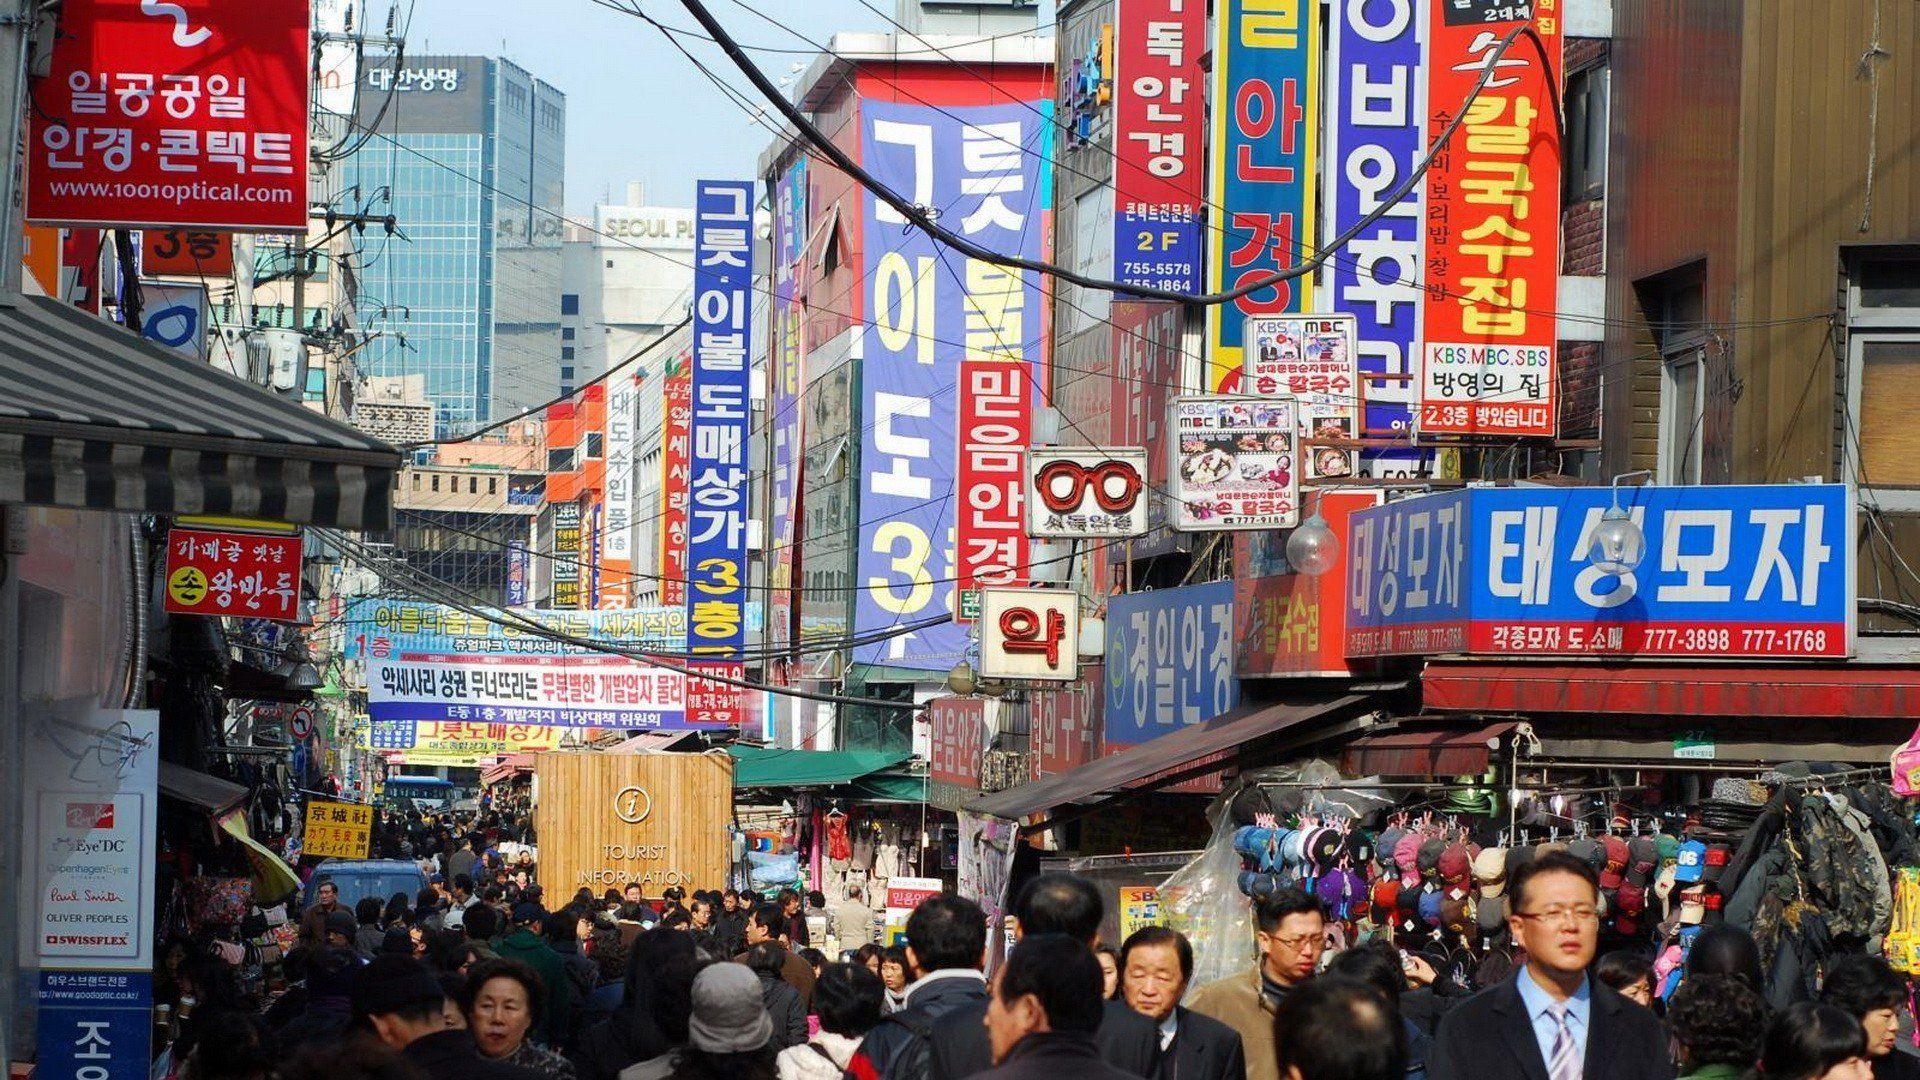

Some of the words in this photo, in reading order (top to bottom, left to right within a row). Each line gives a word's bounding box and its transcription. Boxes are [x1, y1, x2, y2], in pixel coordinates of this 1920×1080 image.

[1451, 32, 1530, 88] 손
[369, 68, 458, 91] 대한생명
[1128, 0, 1190, 178] 독안경
[69, 70, 246, 119] 일공공일
[873, 119, 1025, 236] 그릇
[50, 181, 292, 205] www.1001optical.com
[605, 218, 671, 238] SEOUL
[1458, 96, 1538, 336] 칼국수집
[153, 228, 218, 260] 3층
[1123, 262, 1191, 276] 755-5578
[1123, 279, 1191, 292] 755-1864
[874, 252, 1024, 362] 이불
[1258, 322, 1287, 333] KBS
[1433, 346, 1548, 367] KBS.MBC.SBS
[1256, 376, 1277, 394] 손
[1288, 375, 1350, 393] 칼국수
[1433, 372, 1503, 397] 방영의
[1520, 374, 1540, 398] 집
[1181, 404, 1205, 415] KBS
[1425, 404, 1468, 427] 2.3층
[1475, 406, 1548, 428] 방있습니다
[965, 370, 1028, 586] 믿음안경
[1215, 501, 1232, 516] 손
[253, 543, 286, 562] 옛날
[1351, 500, 1463, 617] 태성모자
[1489, 505, 1831, 609] 태성모자
[173, 570, 203, 600] 손
[209, 569, 295, 612] 왕만두
[692, 558, 742, 640] 3층
[375, 605, 489, 637] 아름다움을
[600, 611, 686, 638] 세계적인
[355, 634, 391, 659] 1층
[999, 606, 1066, 670] 약
[1493, 627, 1561, 652] 각종모자
[1645, 629, 1730, 652] 777-3898
[1742, 629, 1827, 652] 777-1768
[1130, 602, 1234, 728] 경일안경
[382, 666, 436, 697] 악세사리
[440, 669, 468, 698] 상권
[471, 671, 538, 702] 무너뜨리는
[543, 672, 595, 703] 무분별한
[600, 674, 653, 704] 개발업자
[447, 706, 470, 720] E동
[500, 708, 556, 724] 개발저지
[560, 711, 616, 726] 비상대책
[620, 713, 661, 727] 위원회
[311, 806, 367, 826] 京城社
[604, 844, 667, 861] TOURIST
[577, 870, 692, 886] INFORMATION
[51, 886, 78, 902] Paul
[84, 889, 124, 902] Smith
[47, 913, 82, 923] OLIVER
[86, 914, 129, 924] PEOPLES
[58, 934, 127, 946] SWISSFLEX
